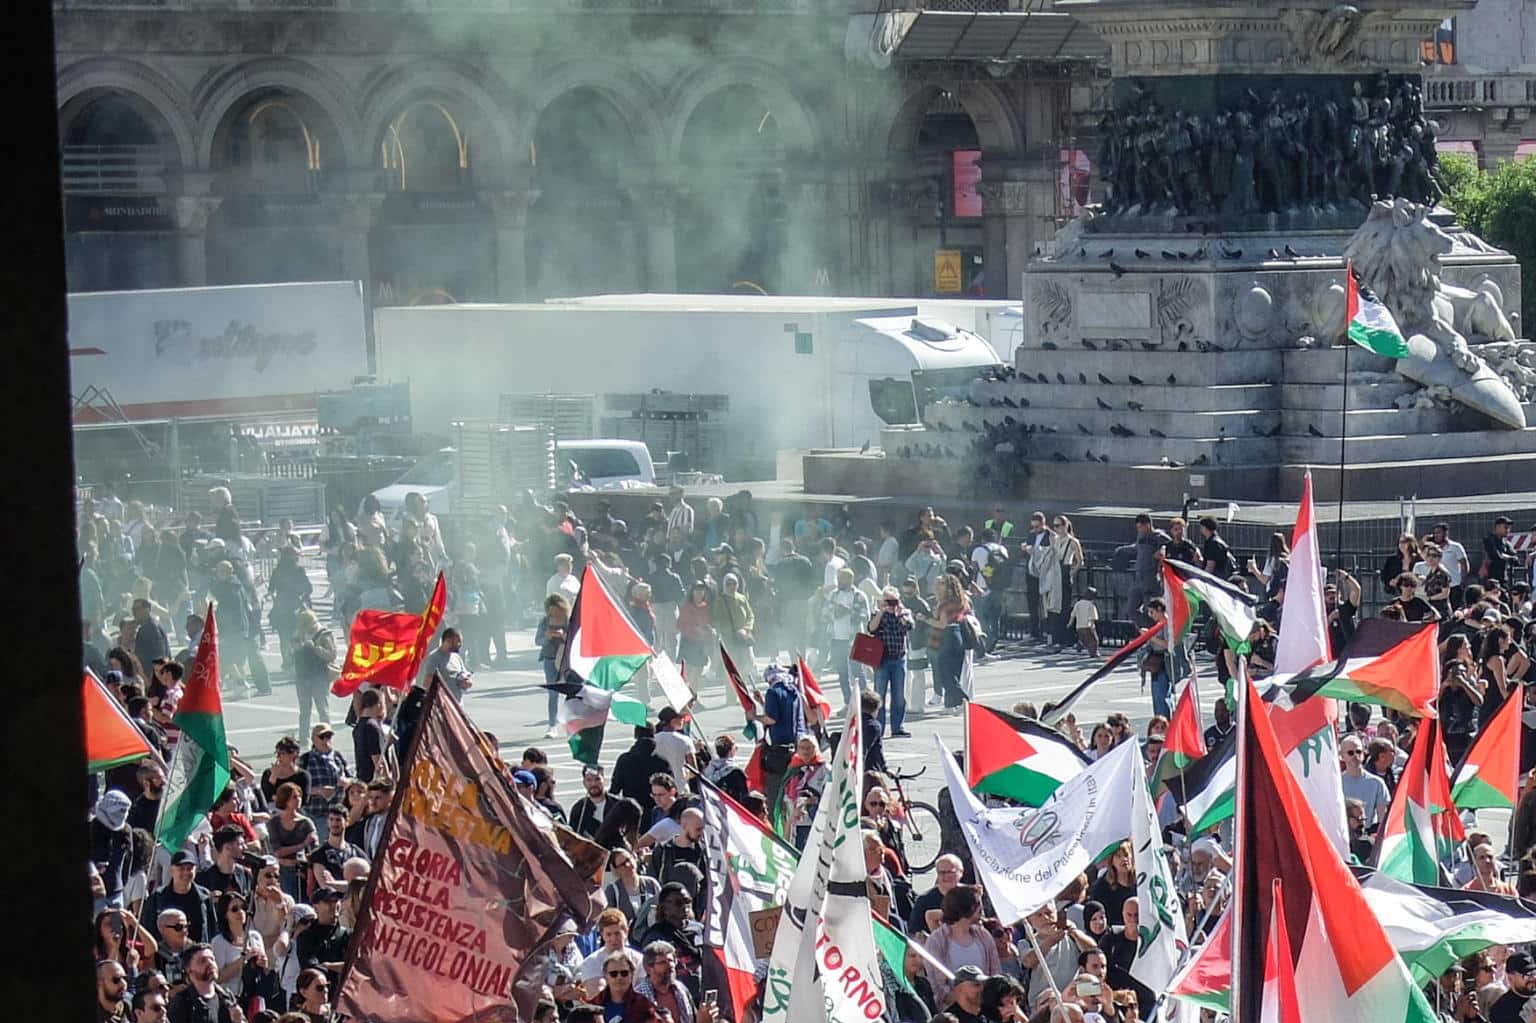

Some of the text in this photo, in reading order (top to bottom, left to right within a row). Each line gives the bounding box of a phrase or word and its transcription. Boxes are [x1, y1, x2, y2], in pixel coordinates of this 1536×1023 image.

[388, 838, 461, 886] GLORIA
[393, 871, 450, 910] ALLA
[373, 886, 487, 954] RESISTENZA
[815, 916, 882, 1020] TORNO
